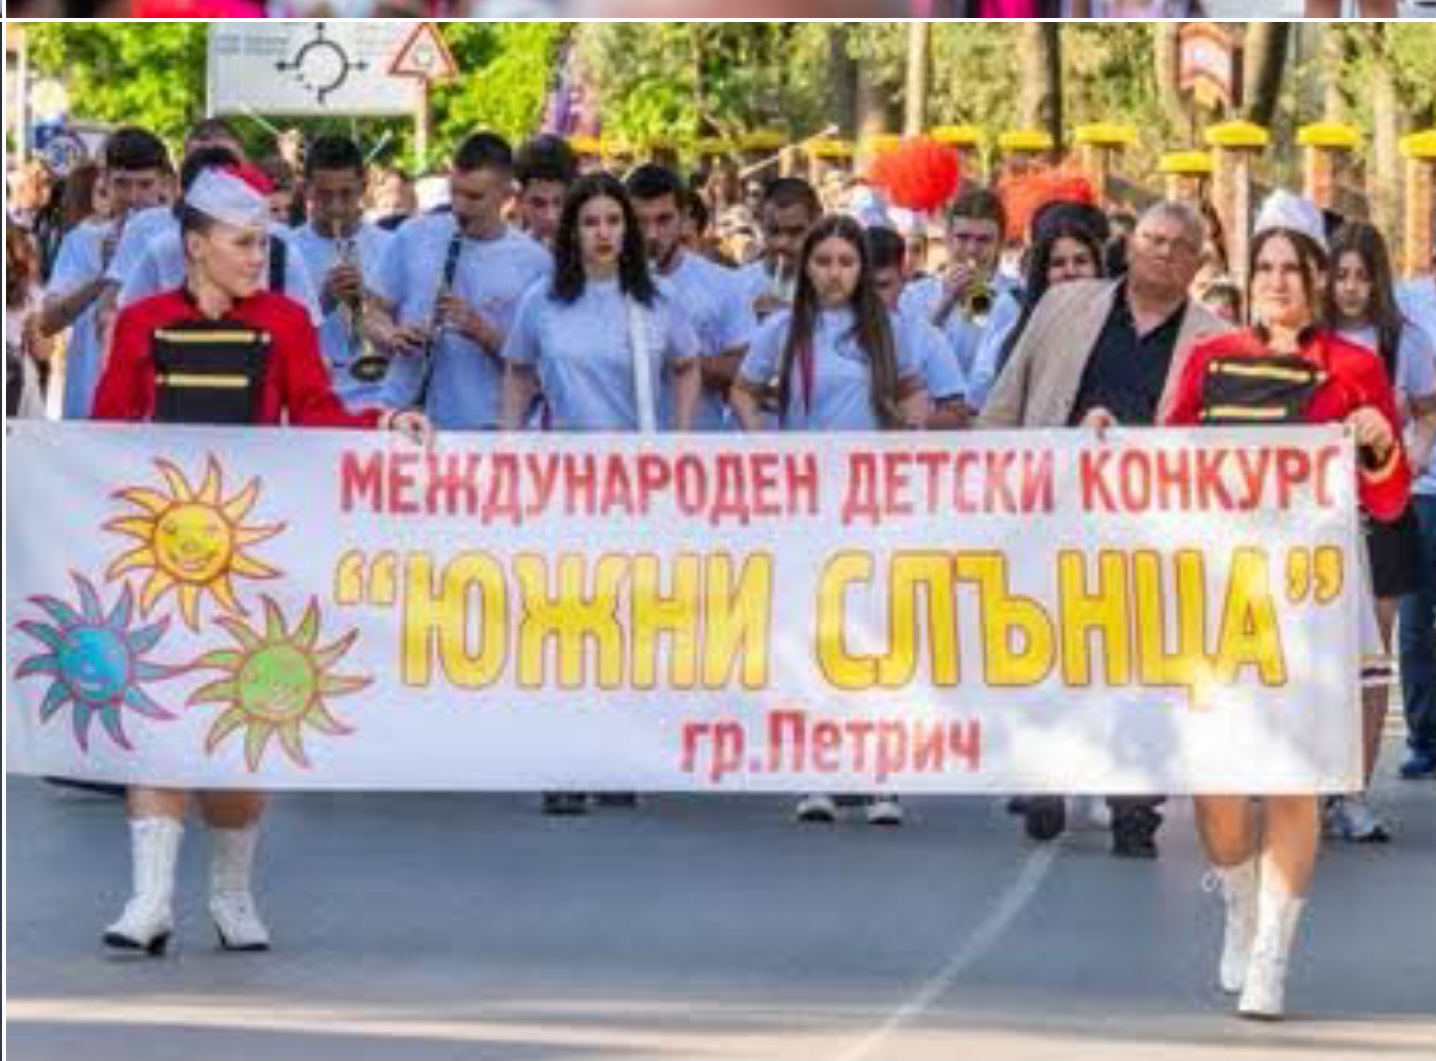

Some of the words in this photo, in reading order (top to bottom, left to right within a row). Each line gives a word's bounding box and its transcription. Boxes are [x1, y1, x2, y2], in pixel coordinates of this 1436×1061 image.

[339, 450, 820, 526] МЕЖДУНАРОДЕН
[840, 449, 1056, 526] ДЕТСКИ
[1078, 445, 1342, 513] КОНКУРС
[680, 709, 982, 783] гр.Петрич
